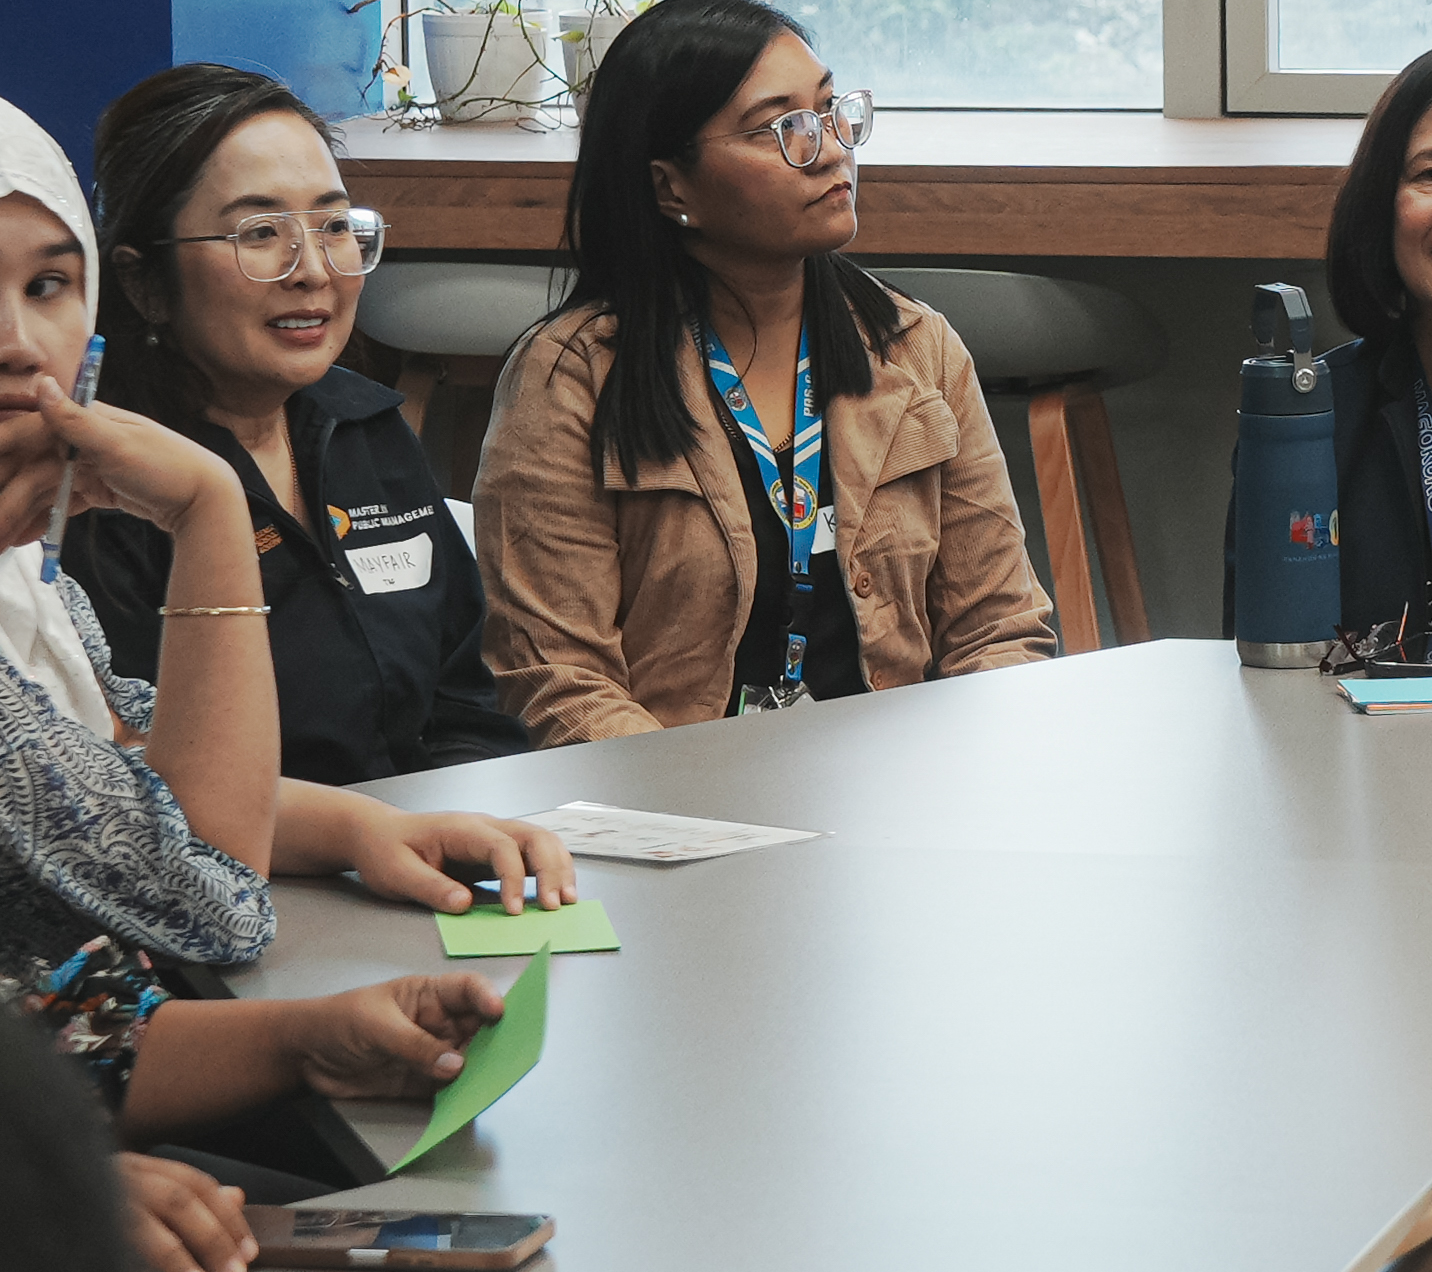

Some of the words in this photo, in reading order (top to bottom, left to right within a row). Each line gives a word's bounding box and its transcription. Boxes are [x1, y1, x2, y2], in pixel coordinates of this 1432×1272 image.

[348, 504, 379, 518] MASTER
[351, 518, 381, 530] PUBLIC
[380, 505, 435, 527] MANAGEME
[352, 551, 417, 575] MAYFAIR
